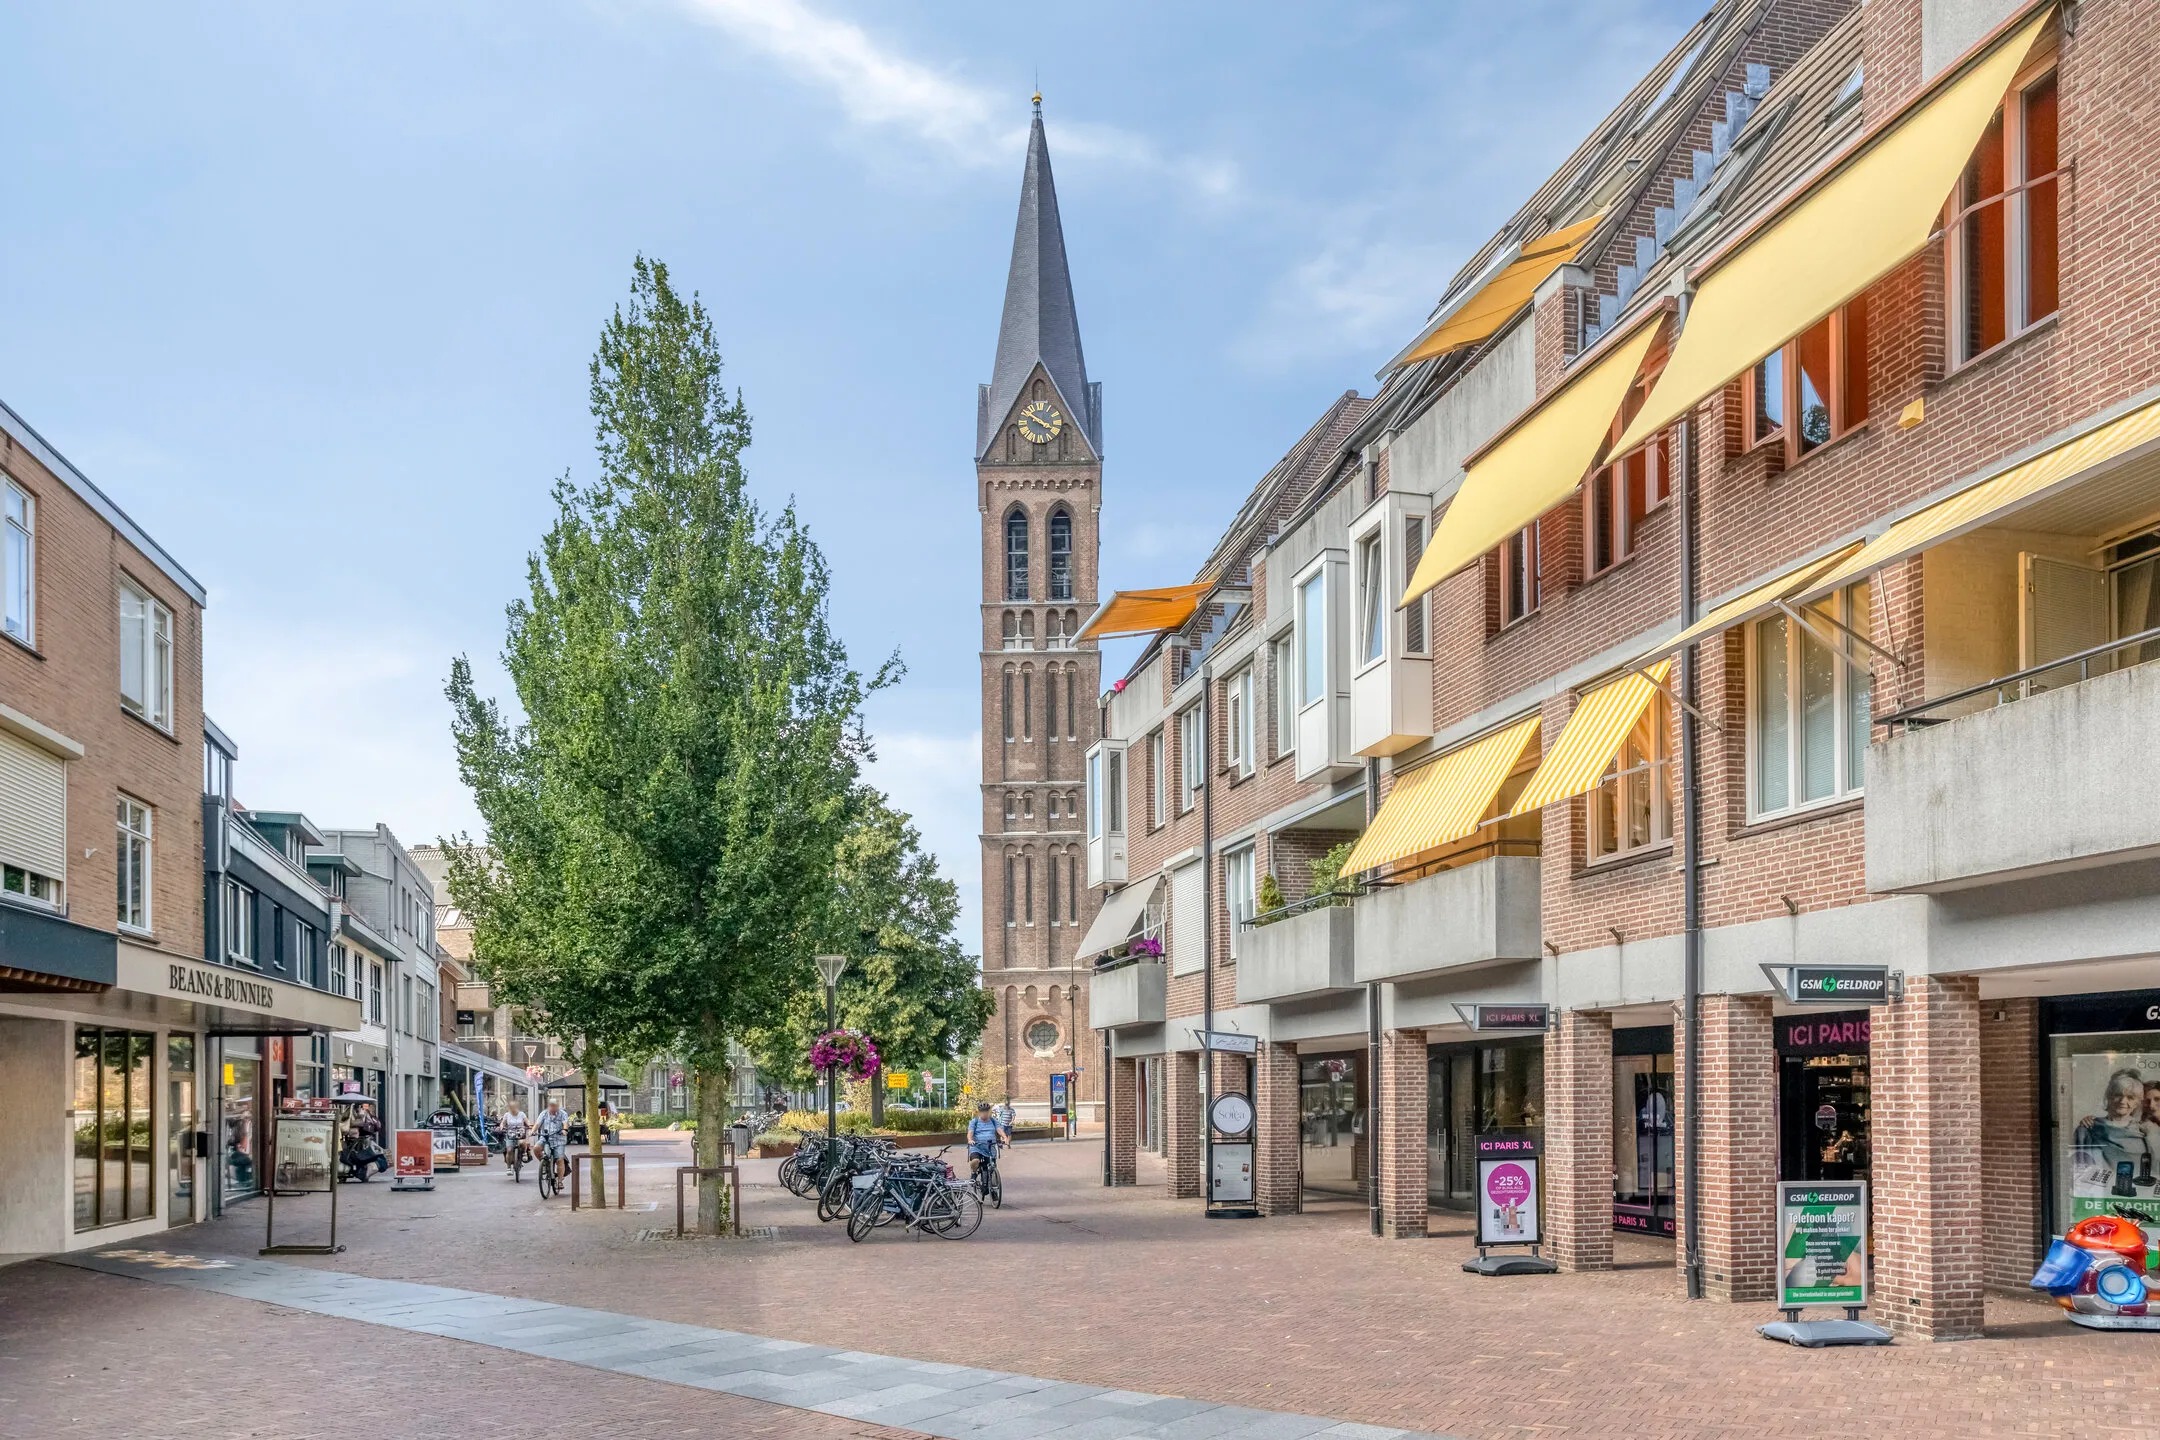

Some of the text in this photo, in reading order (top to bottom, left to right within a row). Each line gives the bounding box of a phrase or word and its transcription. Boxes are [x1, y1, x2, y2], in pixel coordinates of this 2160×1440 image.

[1800, 979, 1883, 990] GSM GELDROP
[2146, 1005, 2160, 1020] G
[1486, 1014, 1540, 1022] ICI PARIS XL
[1789, 1020, 1870, 1046] ICI PARIS
[433, 1115, 454, 1124] KIN
[1480, 1141, 1534, 1151] ICI PARIS XL
[400, 1156, 425, 1166] SALE
[1494, 1175, 1524, 1186] -25%
[1790, 1193, 1855, 1202] GSM GELDROP
[2085, 1200, 2103, 1210] DE
[1618, 1216, 1637, 1226] PARIS
[1639, 1218, 1648, 1227] XL
[1788, 1211, 1855, 1225] Telefoon kapot?
[1663, 1220, 1674, 1230] ICI
